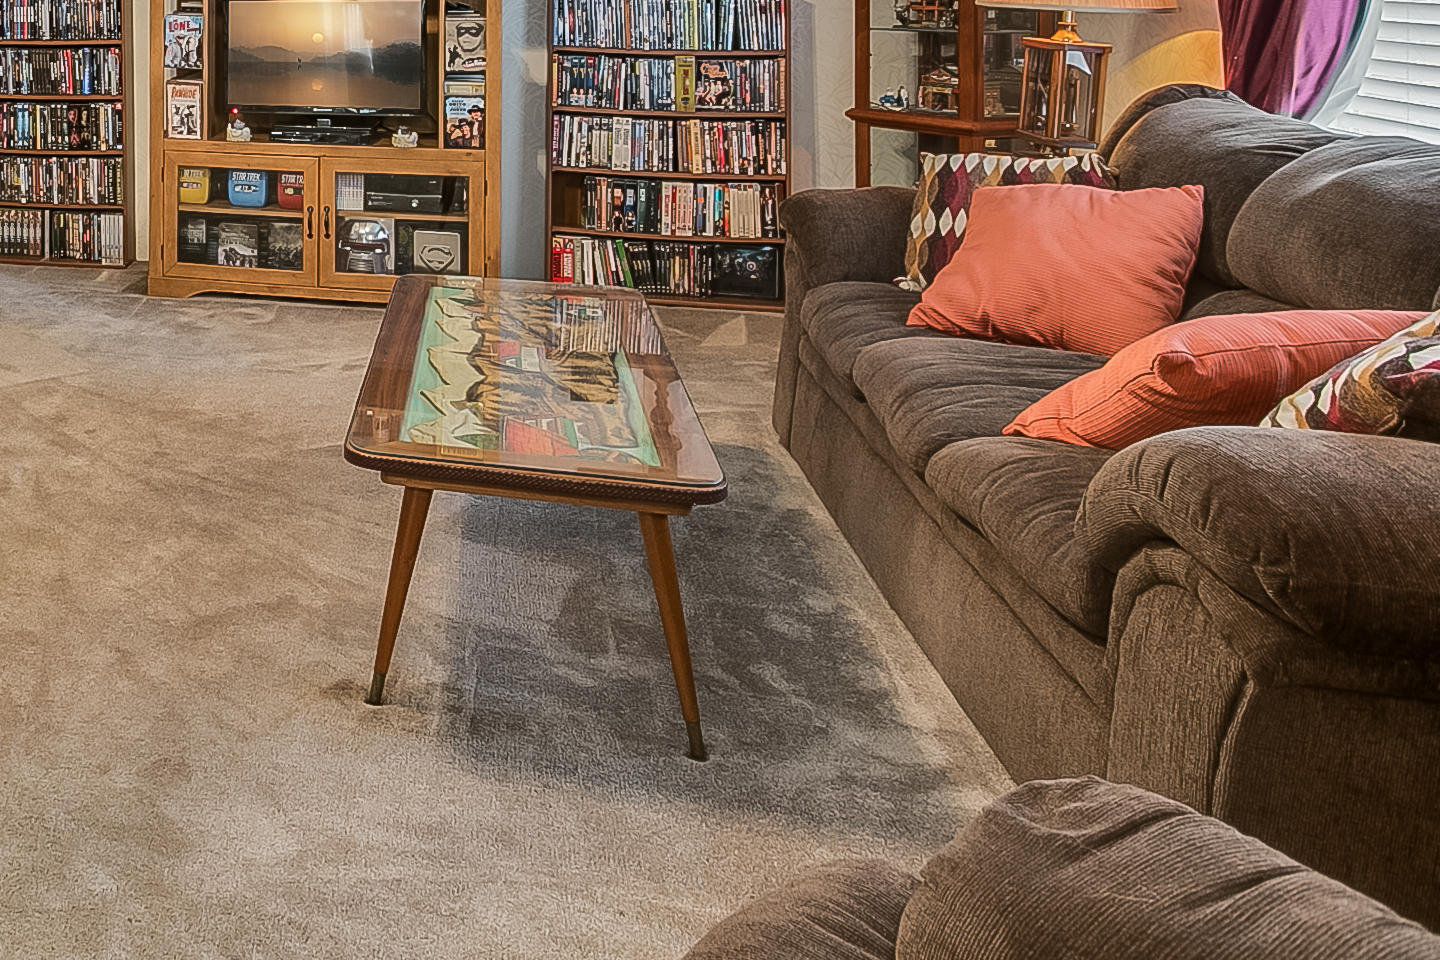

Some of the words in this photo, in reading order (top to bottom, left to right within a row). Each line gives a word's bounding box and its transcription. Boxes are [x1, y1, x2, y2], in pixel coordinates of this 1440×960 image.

[168, 20, 191, 33] LONE
[231, 171, 246, 181] STAR
[246, 172, 261, 182] TREK
[281, 173, 297, 184] STAR
